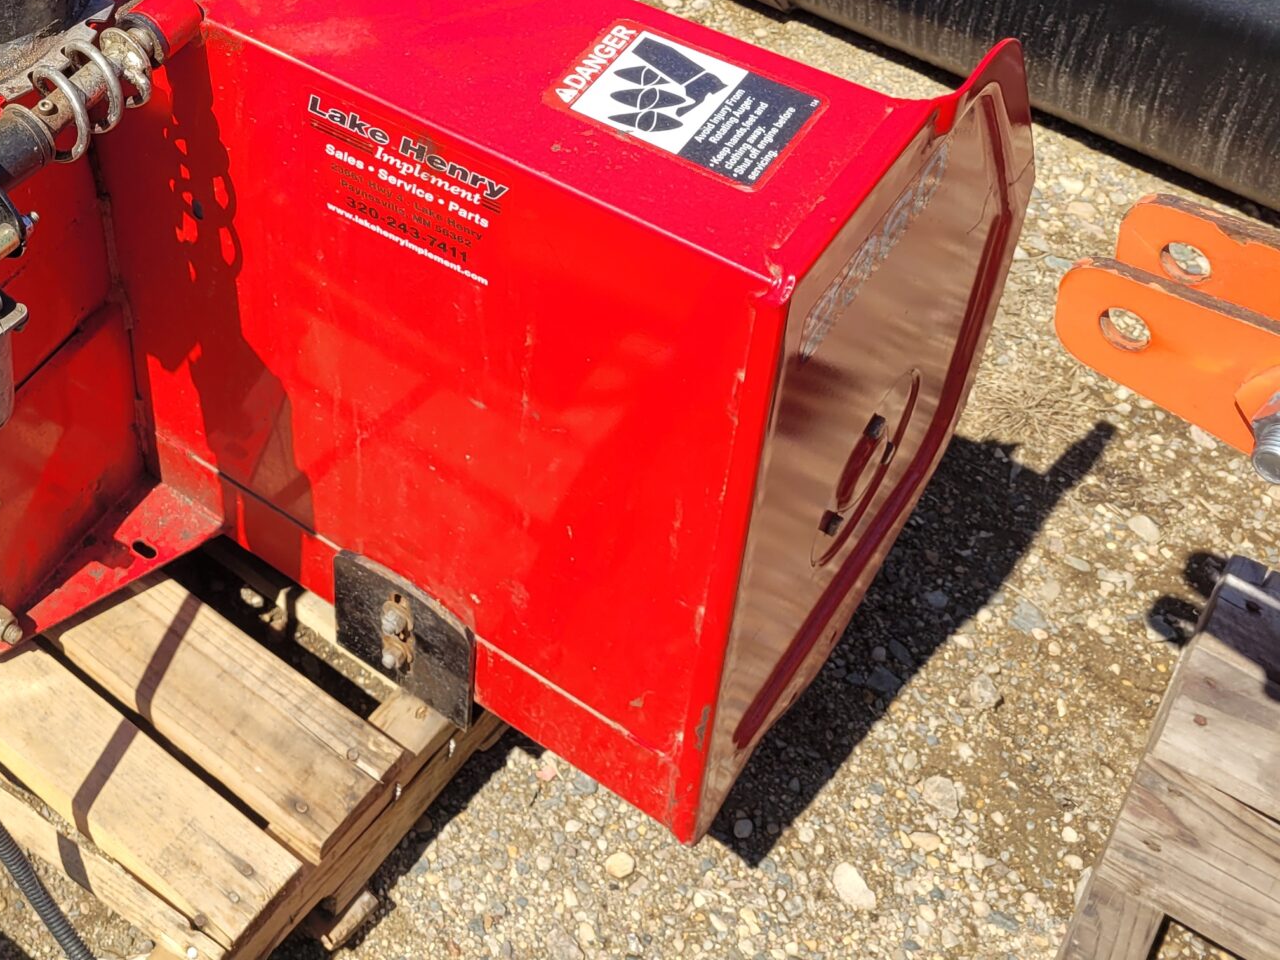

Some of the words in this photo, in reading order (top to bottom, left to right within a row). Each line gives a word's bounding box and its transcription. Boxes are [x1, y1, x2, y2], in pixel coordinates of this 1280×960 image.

[564, 25, 635, 89] DANGER
[694, 122, 715, 143] Avoid
[709, 104, 732, 124] Injury
[724, 88, 745, 106] From
[708, 116, 738, 143] Rotating
[732, 95, 755, 117] Auger:
[709, 146, 730, 164] Keep
[753, 101, 768, 115] and
[733, 157, 753, 174] Shut
[748, 147, 761, 159] off
[756, 127, 778, 149] engine
[772, 106, 795, 128] before
[309, 94, 389, 144] Lake
[399, 136, 507, 199] Henry
[375, 146, 480, 204] Implement
[724, 142, 752, 169] clothing
[746, 125, 765, 144] away.
[747, 150, 777, 180] servicing.
[325, 143, 364, 169] Sales
[377, 168, 433, 201] Service
[447, 200, 488, 227] Parts
[367, 180, 392, 197] Hwy
[413, 203, 441, 220] Lake
[446, 217, 482, 240] Henry
[327, 203, 487, 284] www.lakehenryimplement.com
[347, 197, 466, 261] 320-243-7411
[412, 214, 430, 226] MN
